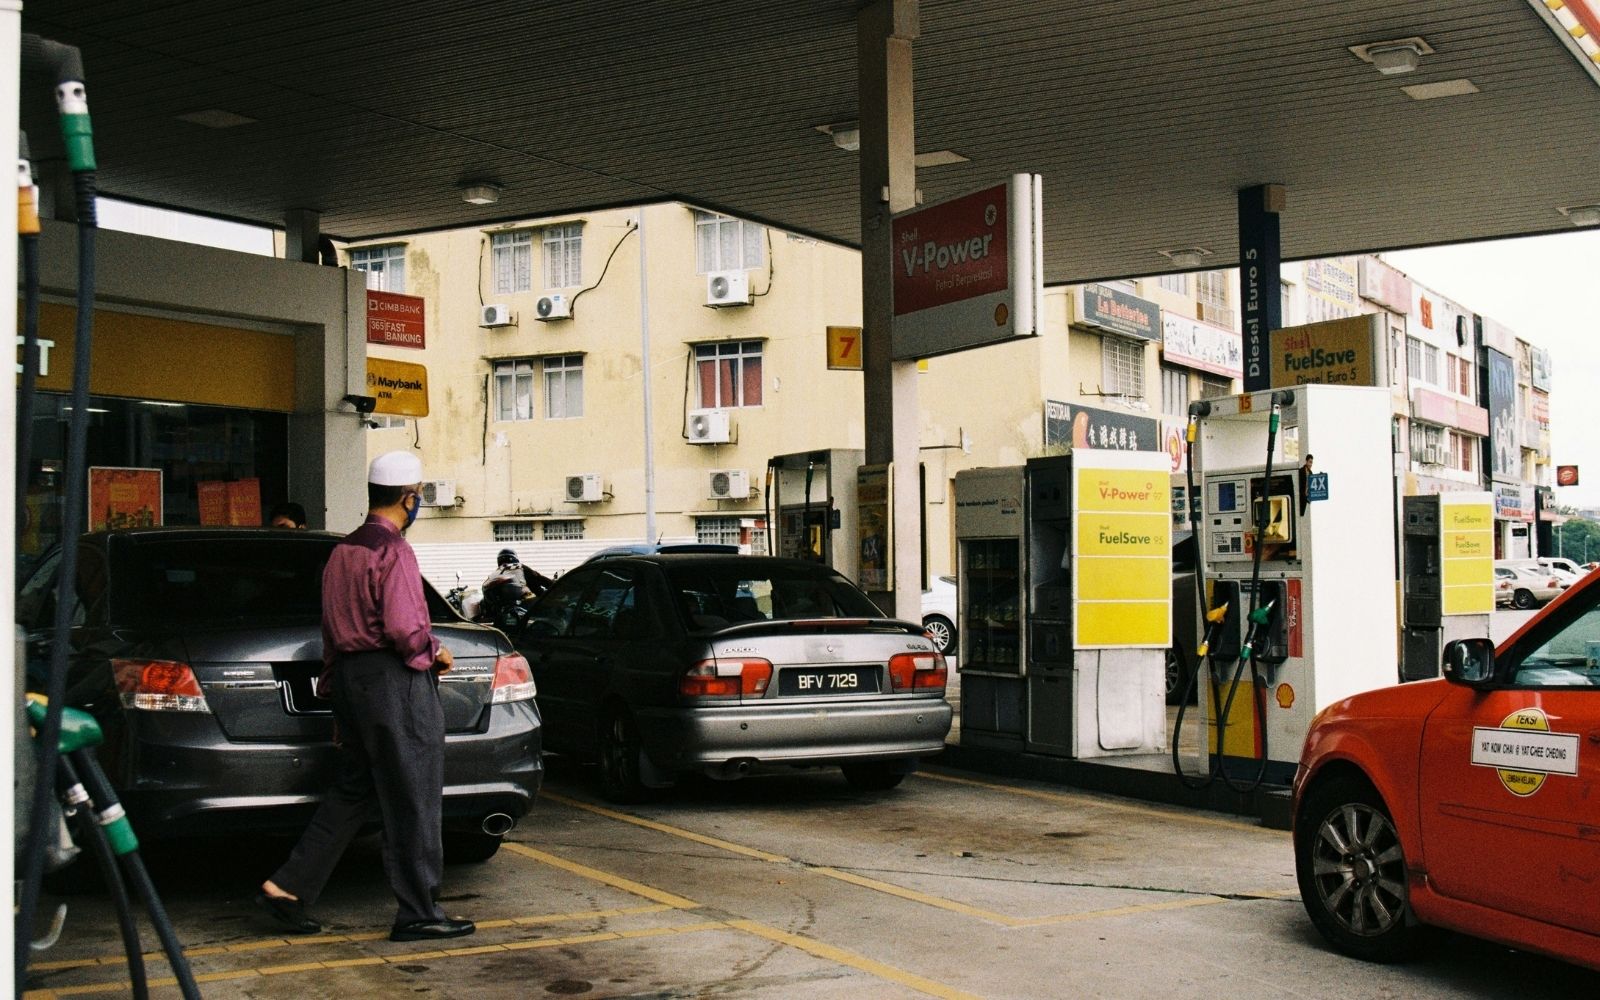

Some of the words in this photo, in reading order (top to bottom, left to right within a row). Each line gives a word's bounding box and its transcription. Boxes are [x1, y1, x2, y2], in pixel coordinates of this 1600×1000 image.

[901, 227, 918, 244] Shell
[902, 233, 993, 277] V-Power
[1246, 248, 1257, 260] 5
[1247, 266, 1259, 312] Euro
[379, 302, 399, 312] CIMB
[400, 304, 420, 314] BANK
[371, 320, 384, 331] 365
[386, 321, 406, 333] FAST
[386, 332, 422, 344] BANKING
[1285, 330, 1311, 350] Shell
[839, 336, 856, 359] 7
[1247, 317, 1261, 378] Diesel
[1284, 348, 1356, 372] FuelSave
[377, 376, 423, 391] Maybank
[1296, 371, 1323, 385] Diesel
[1327, 371, 1348, 384] Euro
[1350, 367, 1357, 380] 5
[377, 391, 393, 400] ATM
[1241, 396, 1250, 410] 15
[1310, 476, 1326, 491] 4X
[1099, 487, 1150, 501] V-Power
[1099, 531, 1151, 544] FuelSave
[798, 674, 823, 690] BFV
[828, 673, 858, 688] 7129
[1516, 715, 1538, 725] TEKSI
[1481, 742, 1490, 753] YAT
[1545, 747, 1567, 760] CHEONG
